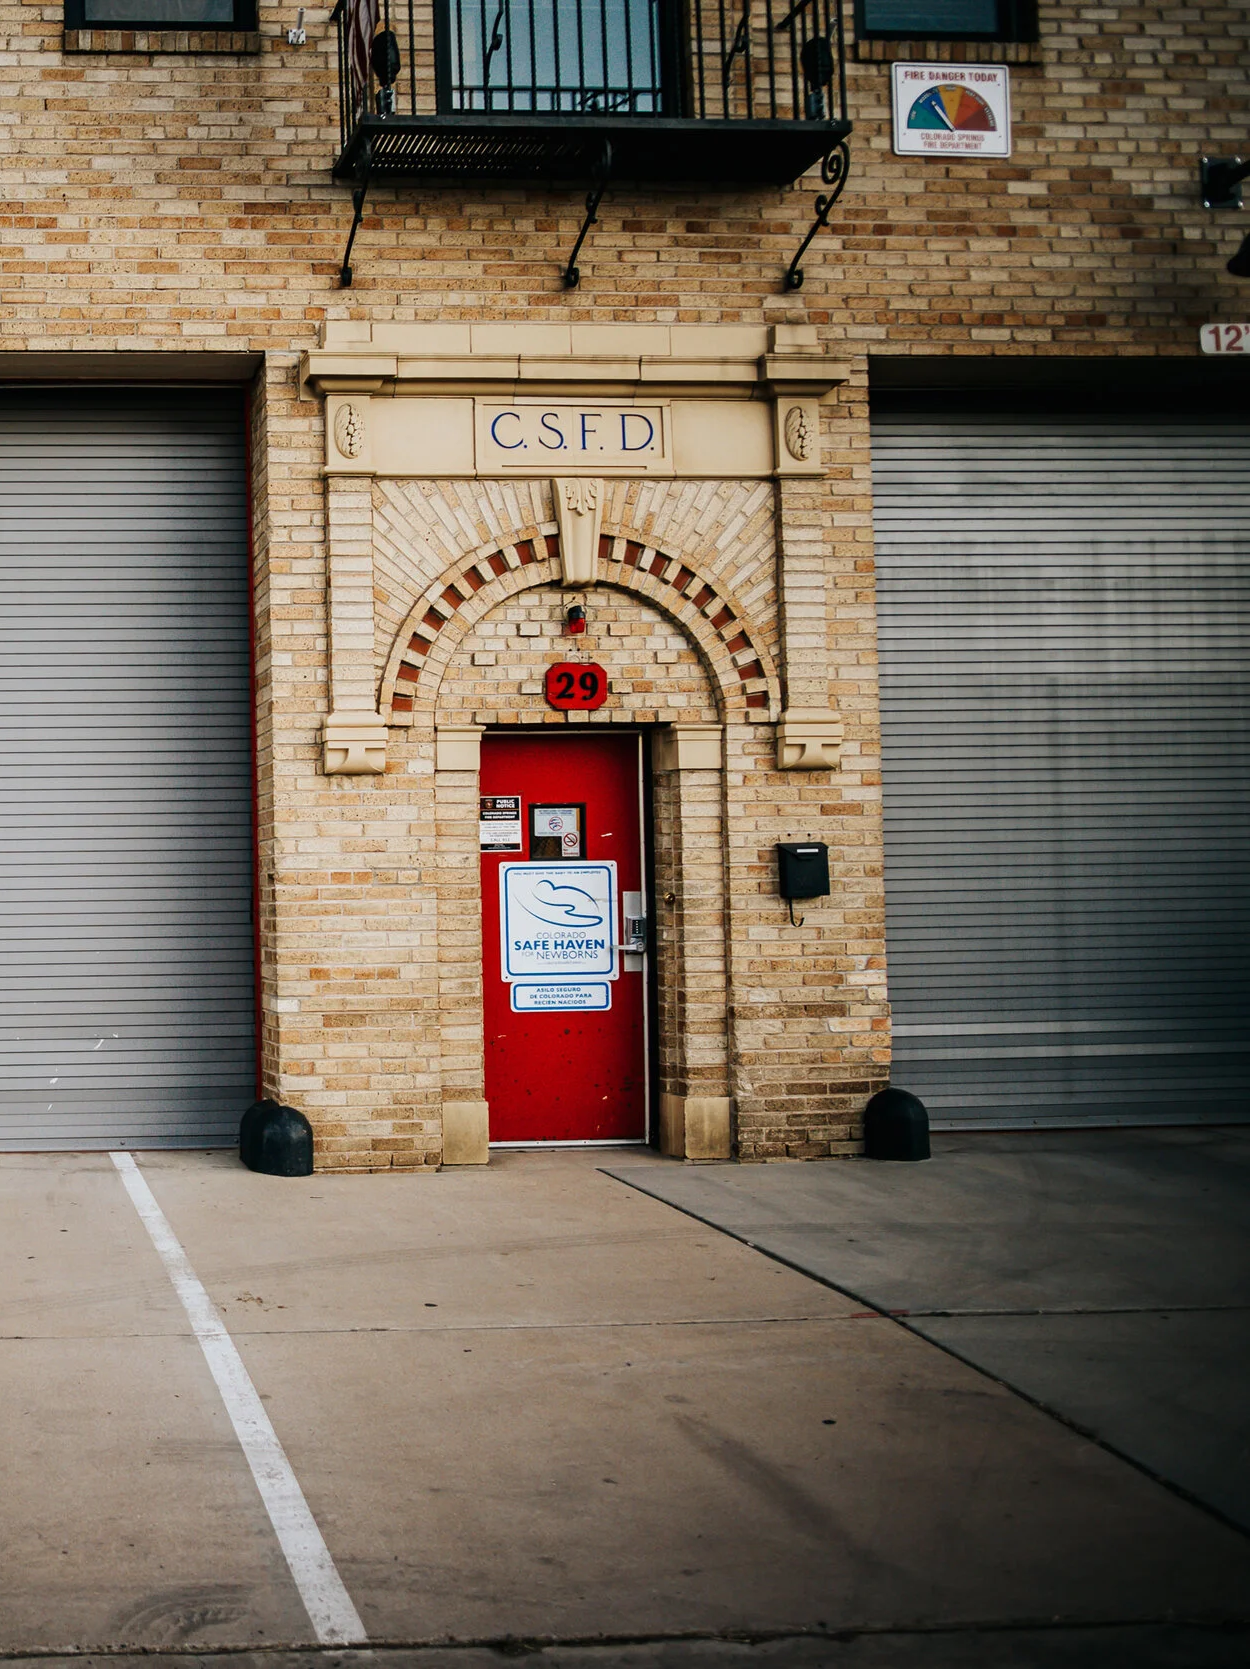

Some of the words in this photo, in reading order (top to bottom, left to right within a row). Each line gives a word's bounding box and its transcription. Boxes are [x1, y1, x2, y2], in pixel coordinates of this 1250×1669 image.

[904, 71, 925, 80] FIRE
[928, 71, 966, 81] DANGER
[968, 72, 998, 82] TODAY
[920, 133, 956, 141] COLORADO
[957, 133, 985, 142] SPRINGS
[923, 141, 938, 149] FIRE
[940, 141, 982, 150] DEPARTMENT
[556, 672, 599, 701] 29
[536, 931, 586, 940] COLORADO
[514, 940, 549, 951] SAFE
[554, 939, 605, 950] HAVEN
[536, 950, 598, 960] NEWBORNS
